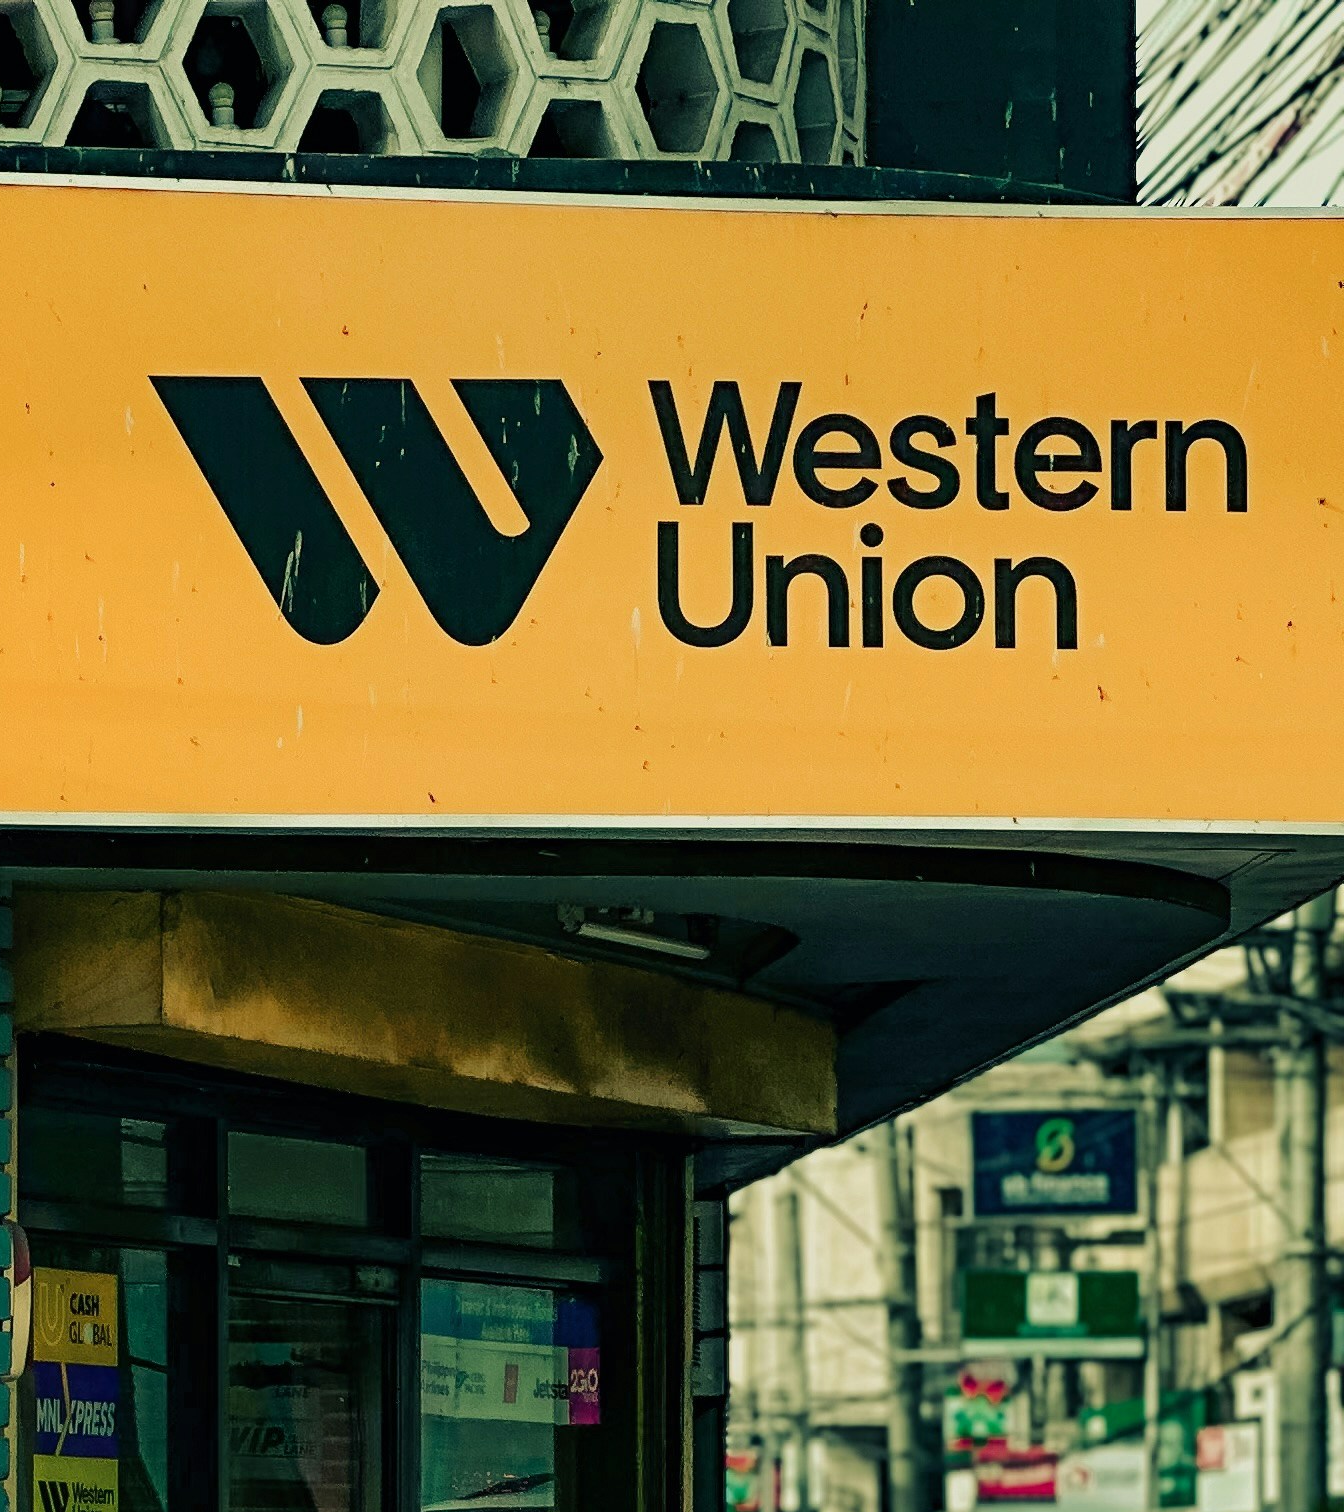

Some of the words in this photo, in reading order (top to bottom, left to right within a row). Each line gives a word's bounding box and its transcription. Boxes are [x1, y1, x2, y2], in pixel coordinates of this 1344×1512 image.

[649, 379, 1249, 513] Western
[657, 522, 1078, 651] Union
[69, 1293, 100, 1316] CASH
[534, 1378, 568, 1399] Jetsta
[72, 1482, 114, 1505] Western
